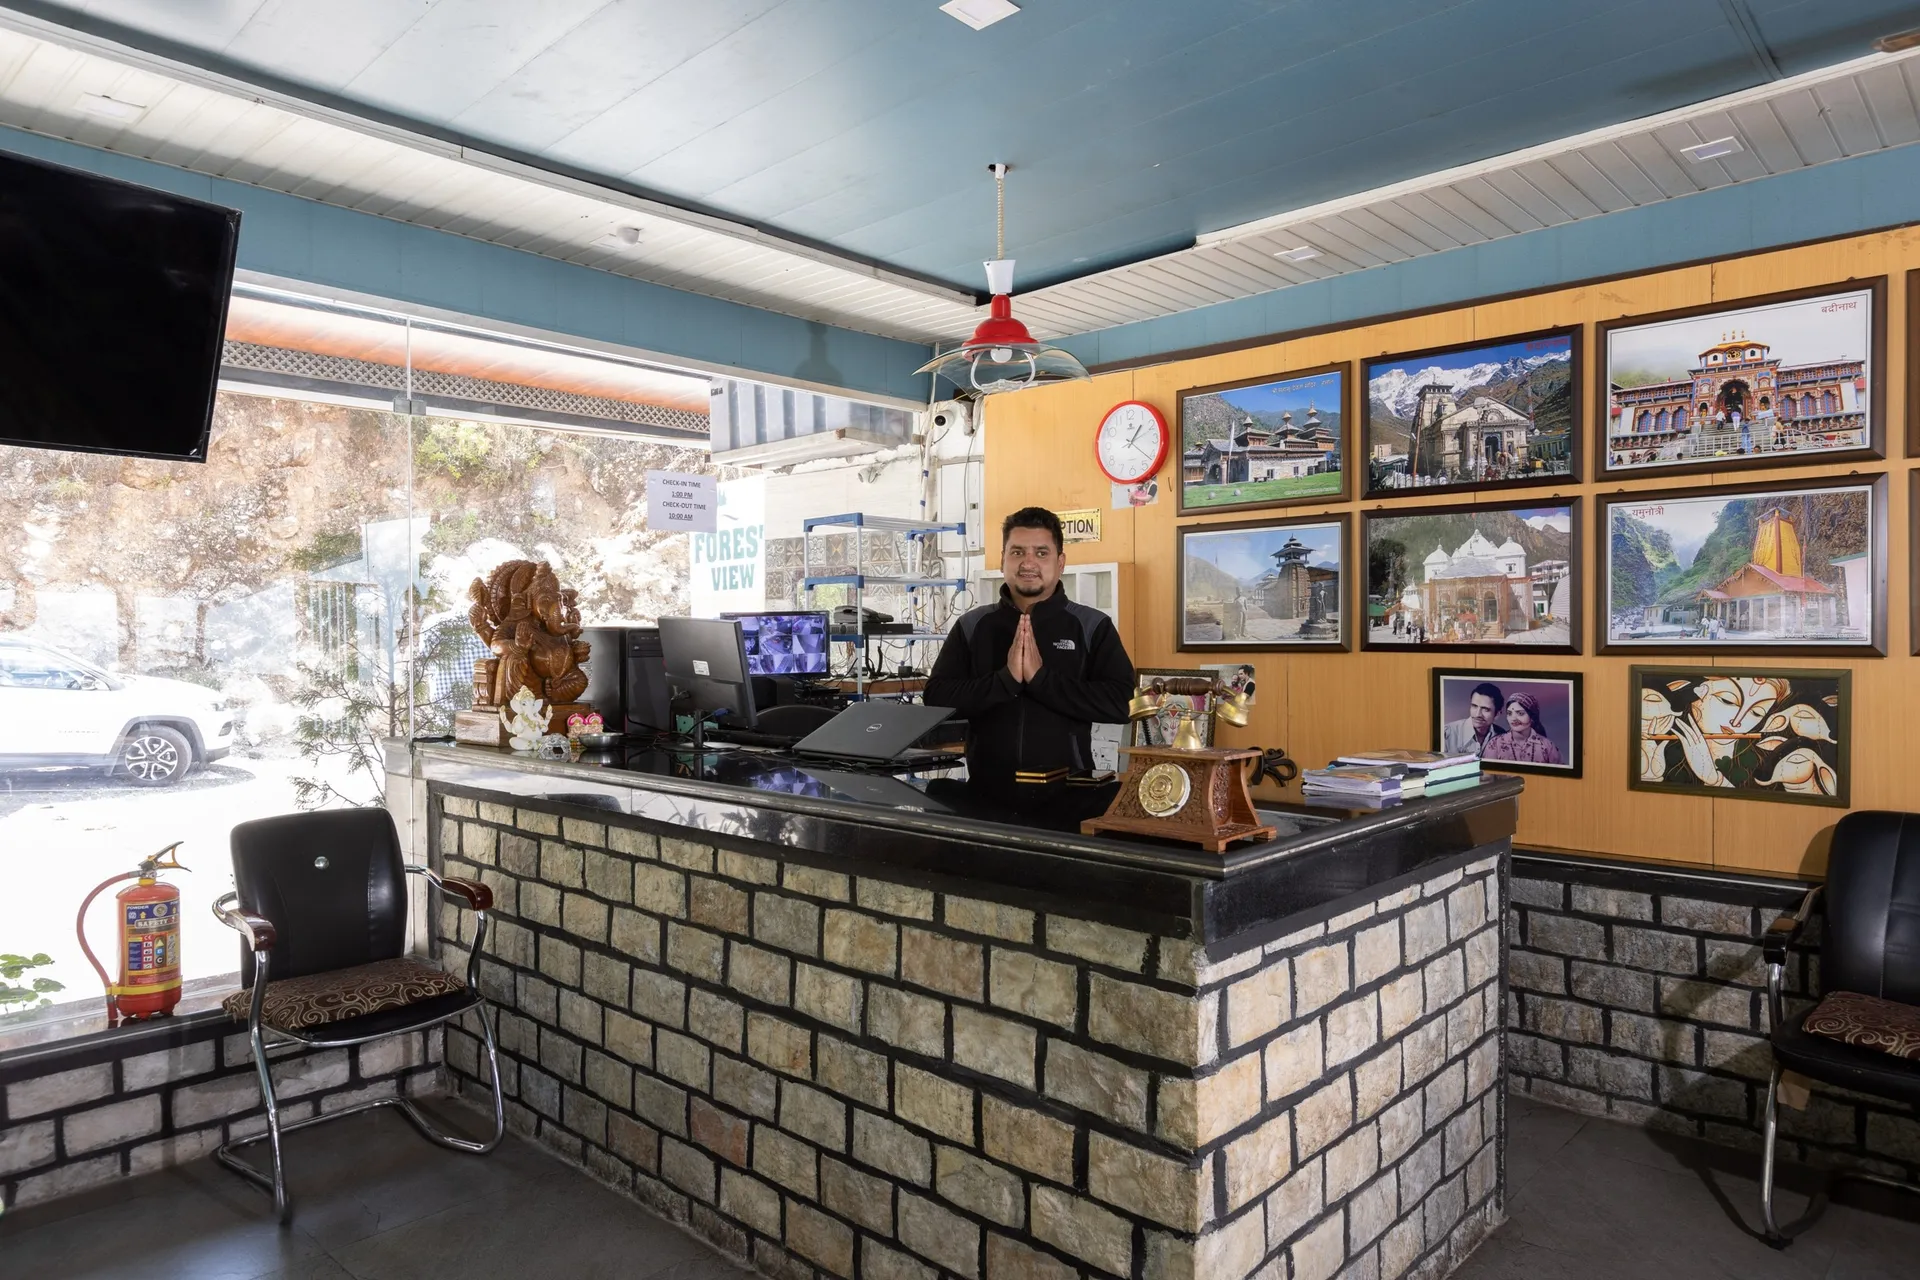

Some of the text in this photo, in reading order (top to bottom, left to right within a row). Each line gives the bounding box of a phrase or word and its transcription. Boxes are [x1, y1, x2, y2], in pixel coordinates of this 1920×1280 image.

[1821, 301, 1857, 313] बद्रीनाथ
[1126, 409, 1134, 420] 12
[1141, 410, 1144, 420] 1
[1115, 415, 1122, 426] 11
[1148, 419, 1155, 430] 2
[1152, 433, 1158, 444] 3
[1109, 455, 1115, 466] 8
[1141, 460, 1149, 471] 5
[1118, 463, 1124, 474] 7
[1129, 465, 1136, 476] 6
[662, 478, 687, 487] CHECK-IN
[662, 501, 692, 509] CHECK-OUT
[668, 512, 683, 520] 10:00
[1060, 519, 1094, 534] PTION
[711, 563, 755, 591] VIEW
[137, 919, 168, 927] SAFETY
